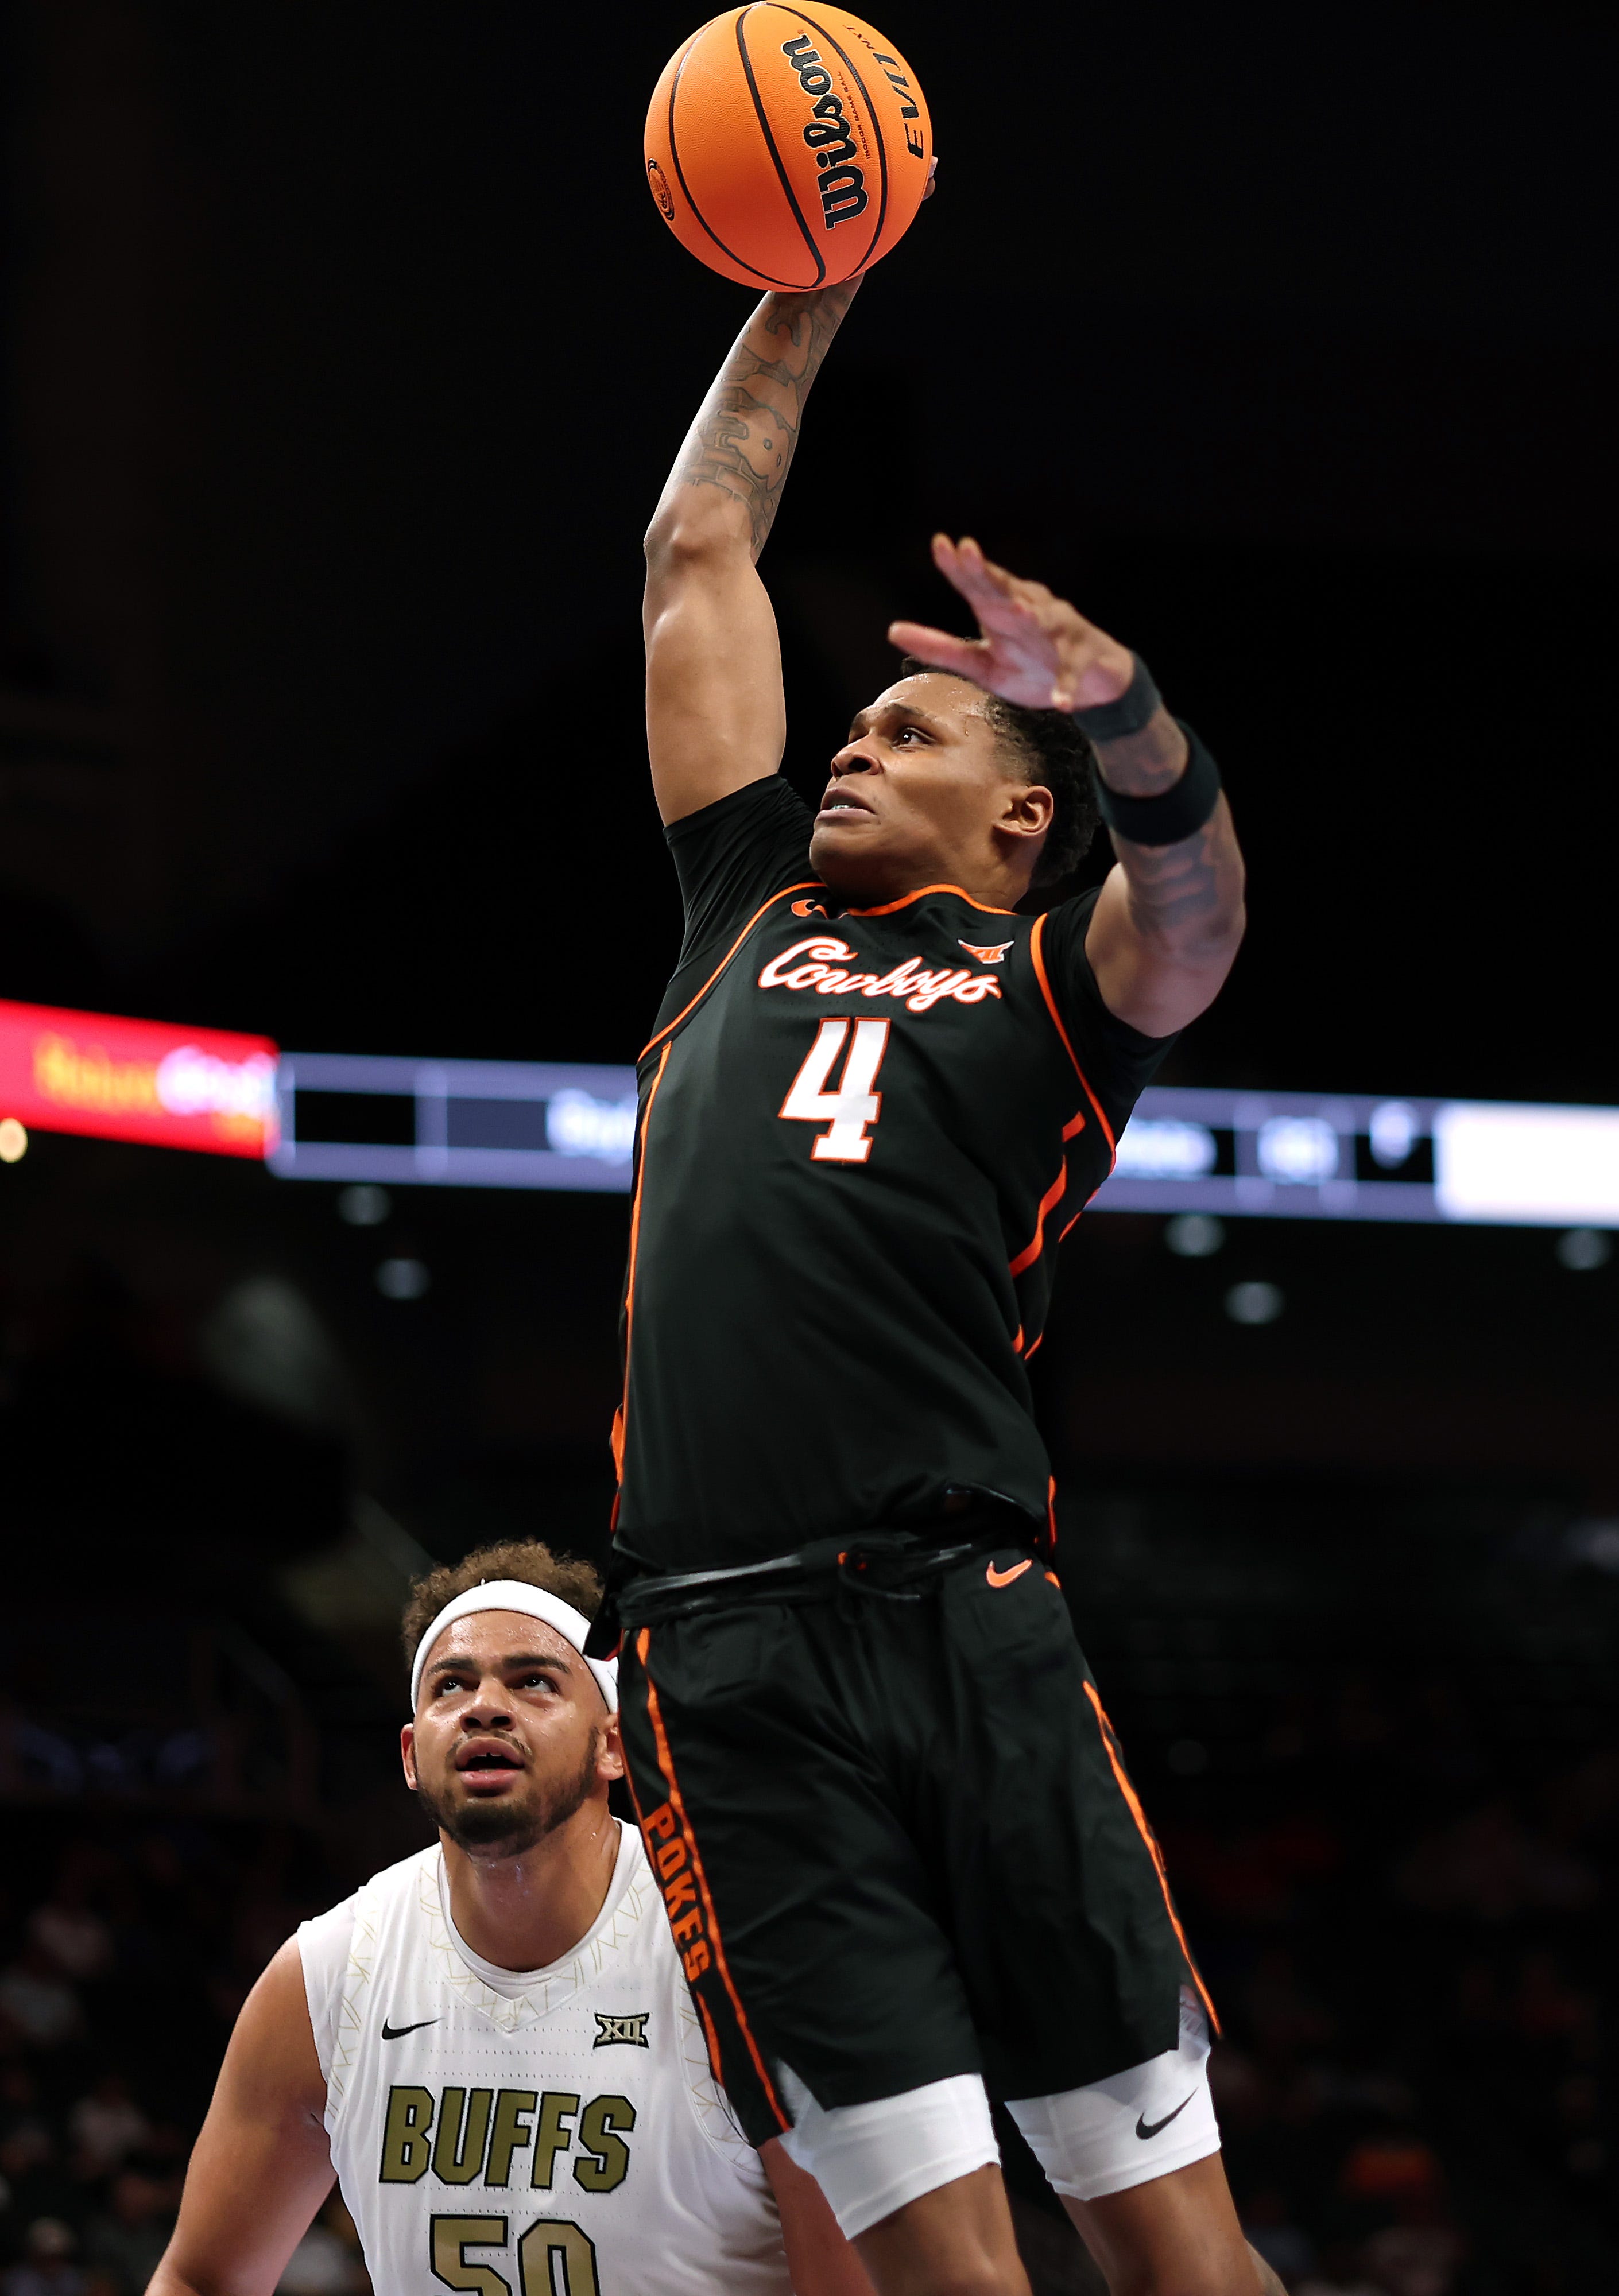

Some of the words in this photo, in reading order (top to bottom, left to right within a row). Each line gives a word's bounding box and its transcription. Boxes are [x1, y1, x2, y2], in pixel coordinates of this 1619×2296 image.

[780, 34, 869, 230] Wilson
[847, 95, 860, 121] GAME
[857, 123, 871, 160] INDOOR
[758, 936, 1002, 1013] Cowboys
[778, 1017, 891, 1163] 4
[643, 1802, 711, 1982] POKES
[595, 2014, 649, 2047] XII
[379, 2085, 637, 2193] BUFFS
